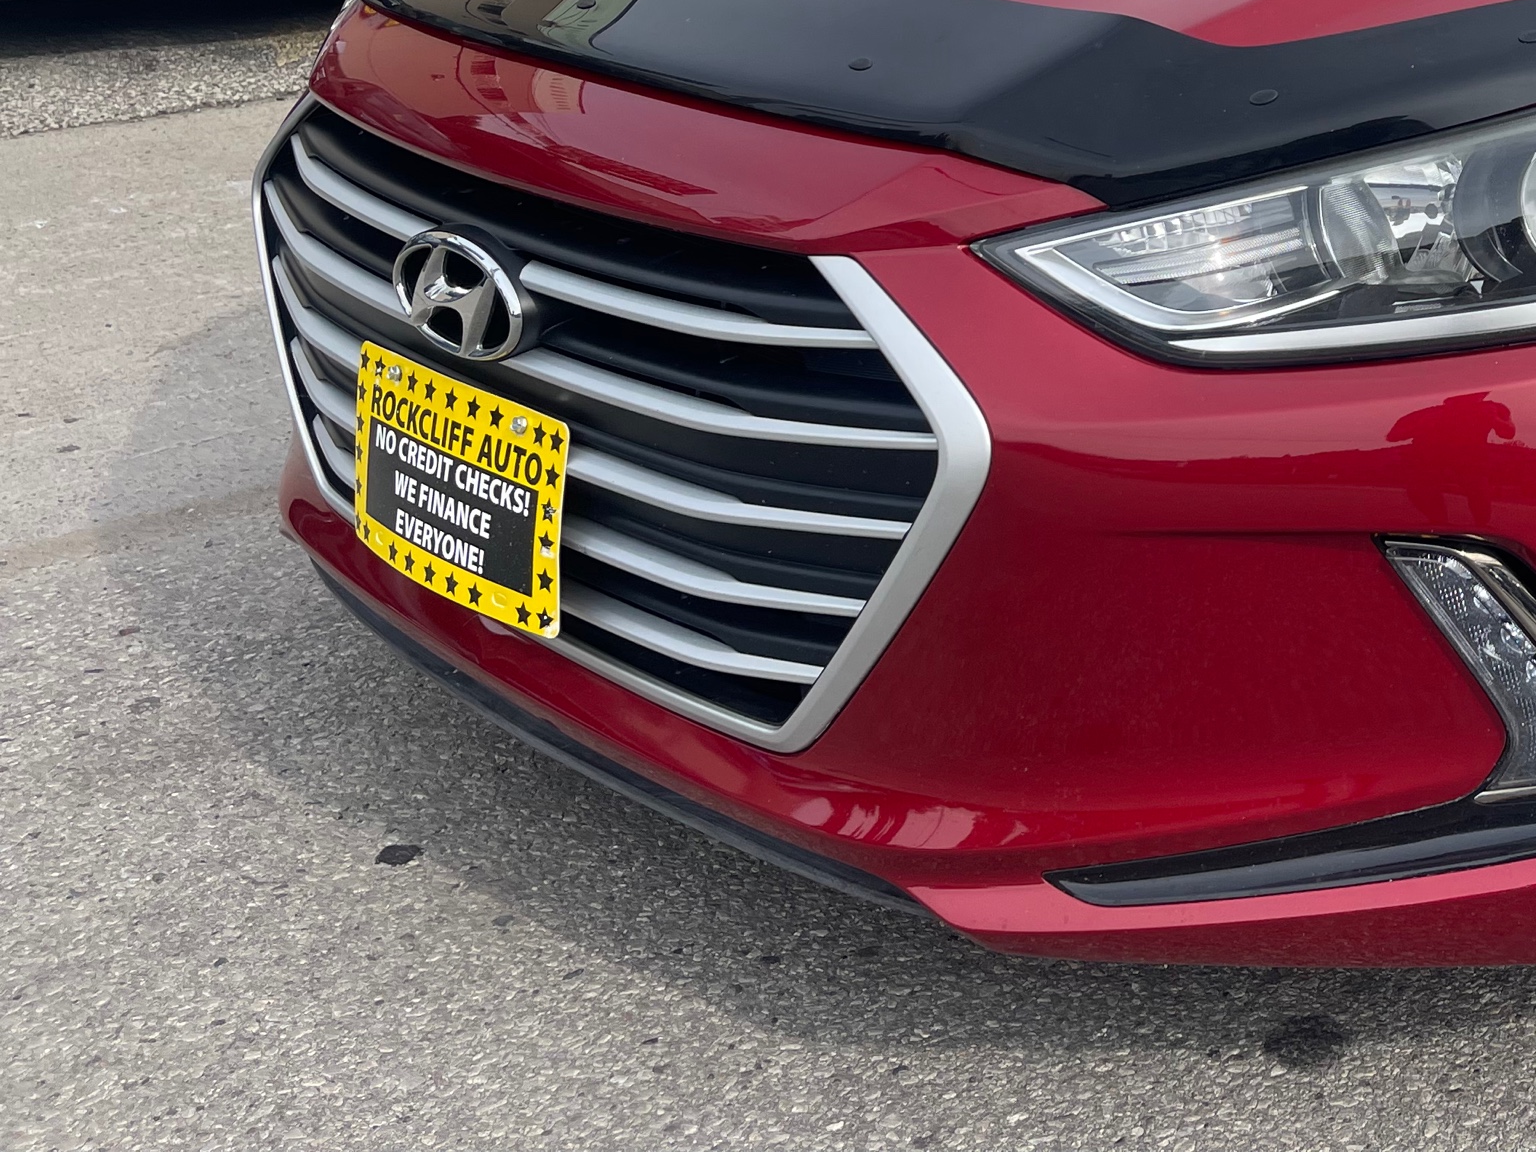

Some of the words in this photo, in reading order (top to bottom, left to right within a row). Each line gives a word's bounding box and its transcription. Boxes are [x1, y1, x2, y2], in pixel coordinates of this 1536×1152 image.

[371, 385, 474, 456] ROCKCLIFF
[477, 433, 543, 486] AUTO
[375, 424, 397, 456] NO
[399, 436, 454, 483] CREDIT
[455, 463, 530, 517] CHECKS!
[394, 470, 416, 504] WE
[418, 484, 491, 540] FINANCE
[396, 508, 485, 575] EVERYONE!
